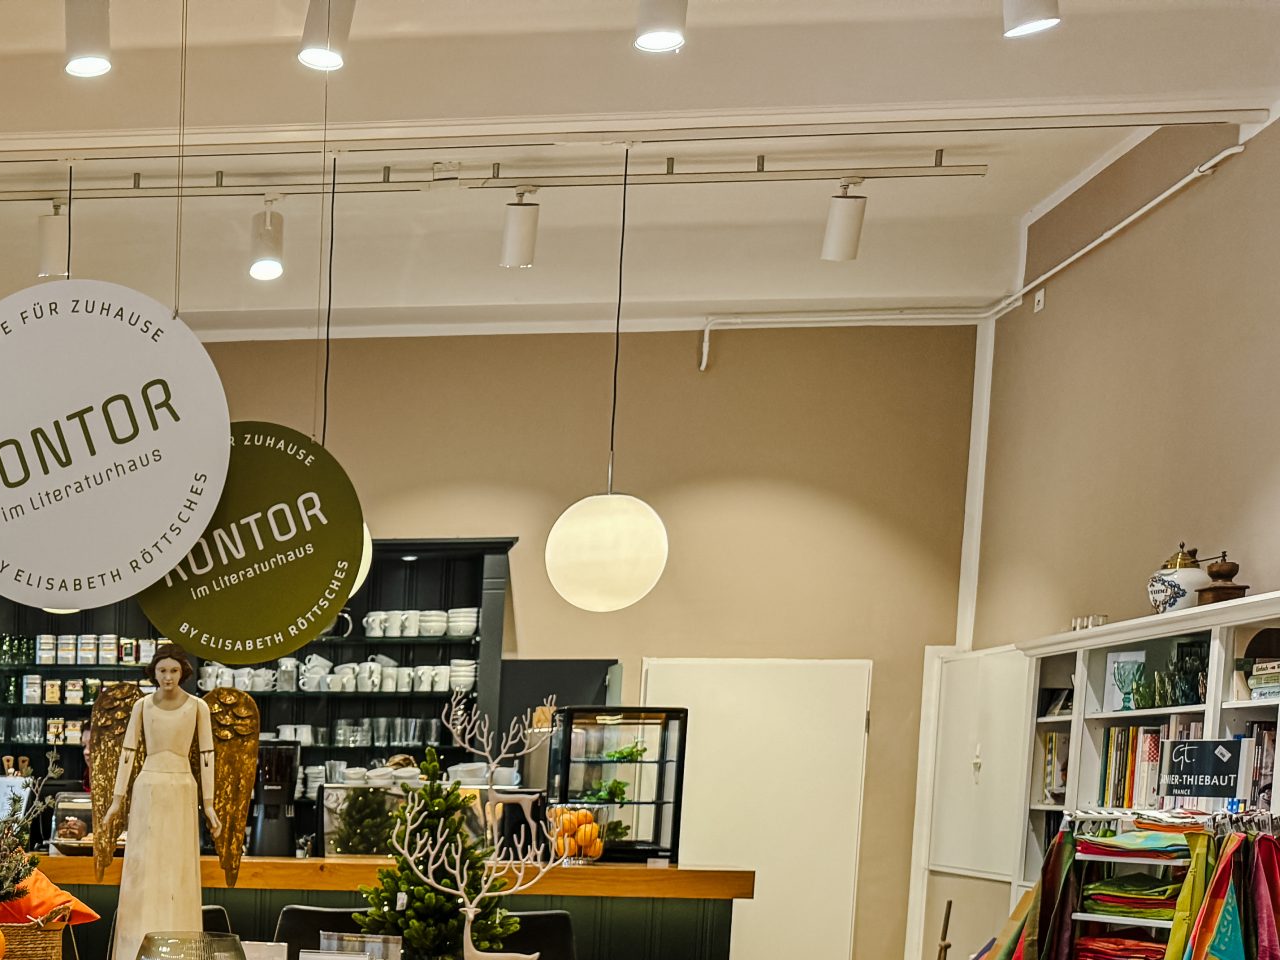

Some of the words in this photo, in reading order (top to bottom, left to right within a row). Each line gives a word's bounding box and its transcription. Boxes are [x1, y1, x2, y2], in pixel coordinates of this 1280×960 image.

[20, 301, 58, 324] FÜR
[72, 300, 164, 342] ZUHAUSE
[244, 434, 315, 466] ZUHAUSE
[1, 504, 25, 522] im
[30, 449, 162, 511] Literaturhaus
[14, 569, 122, 592] ELISABETH
[130, 472, 207, 573] RÖTTSCHES
[190, 586, 209, 600] im
[212, 544, 314, 591] Literaturhaus
[179, 623, 198, 638] BY
[201, 632, 283, 651] ELISABETH
[288, 560, 348, 636] RÖTTSCHES
